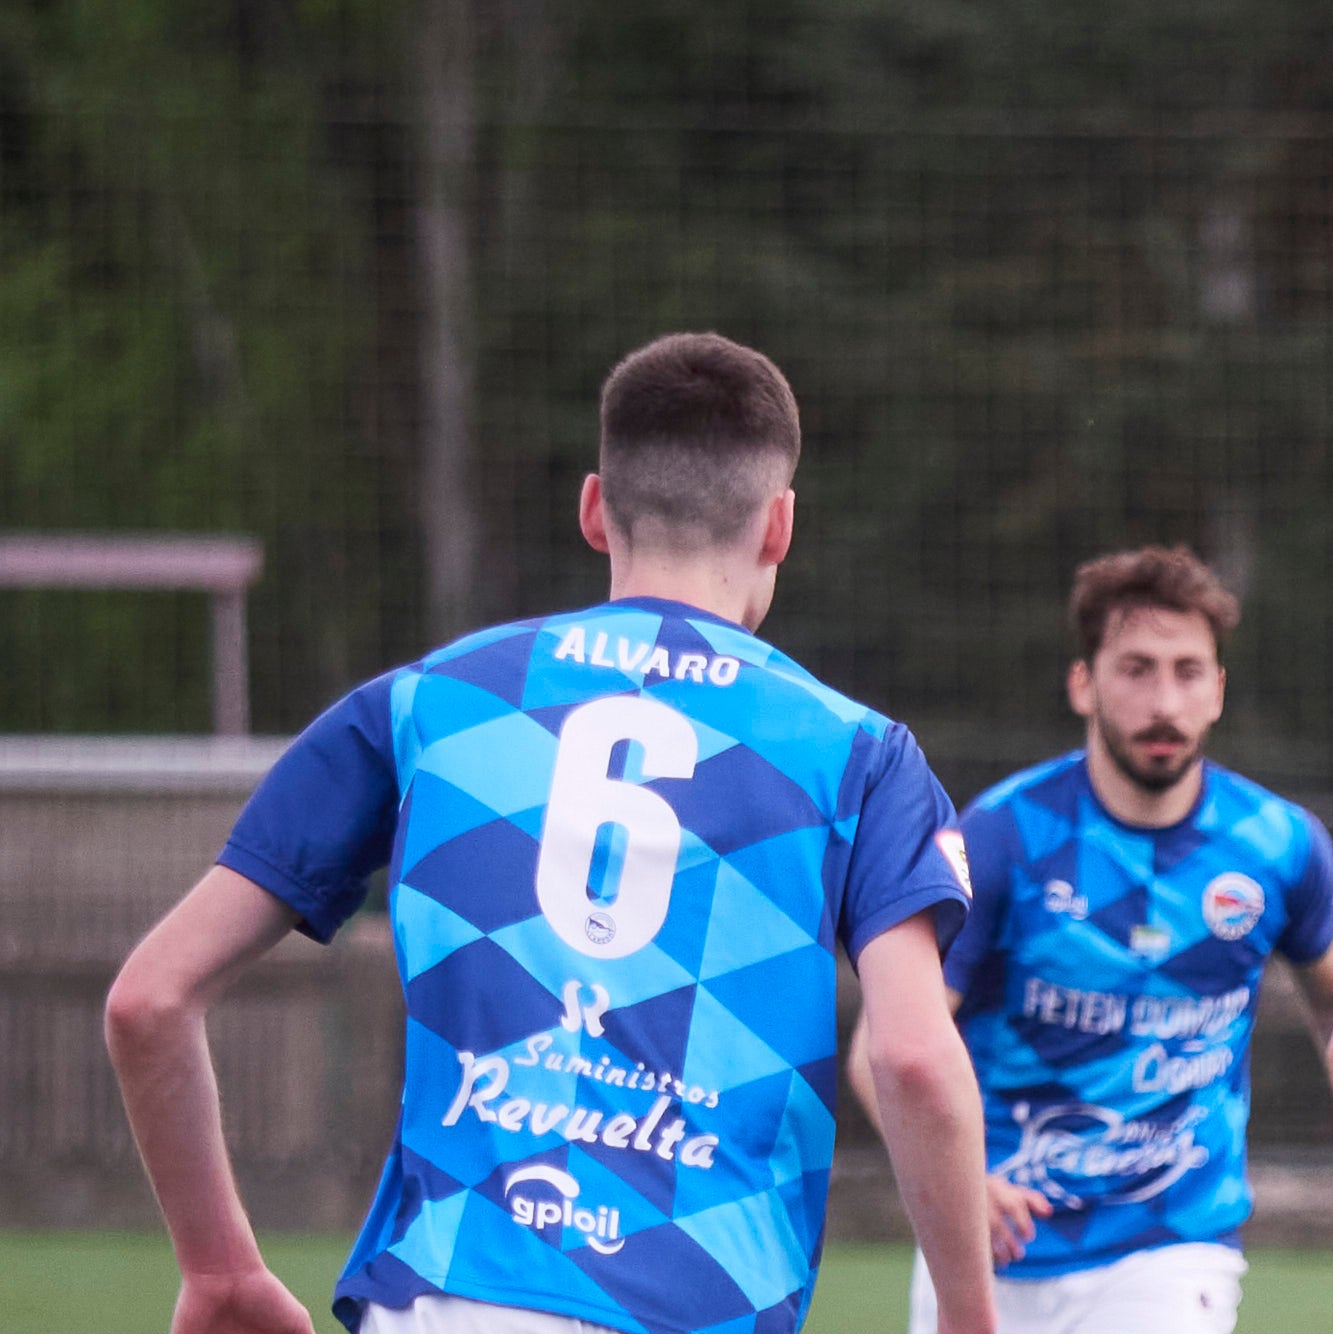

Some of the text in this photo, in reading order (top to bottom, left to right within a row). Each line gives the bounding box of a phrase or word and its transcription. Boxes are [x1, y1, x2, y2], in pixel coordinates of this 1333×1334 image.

[554, 626, 741, 687] ALVARO
[534, 695, 698, 960] 6
[441, 1051, 719, 1170] Revuelta
[513, 1034, 719, 1109] Suministros
